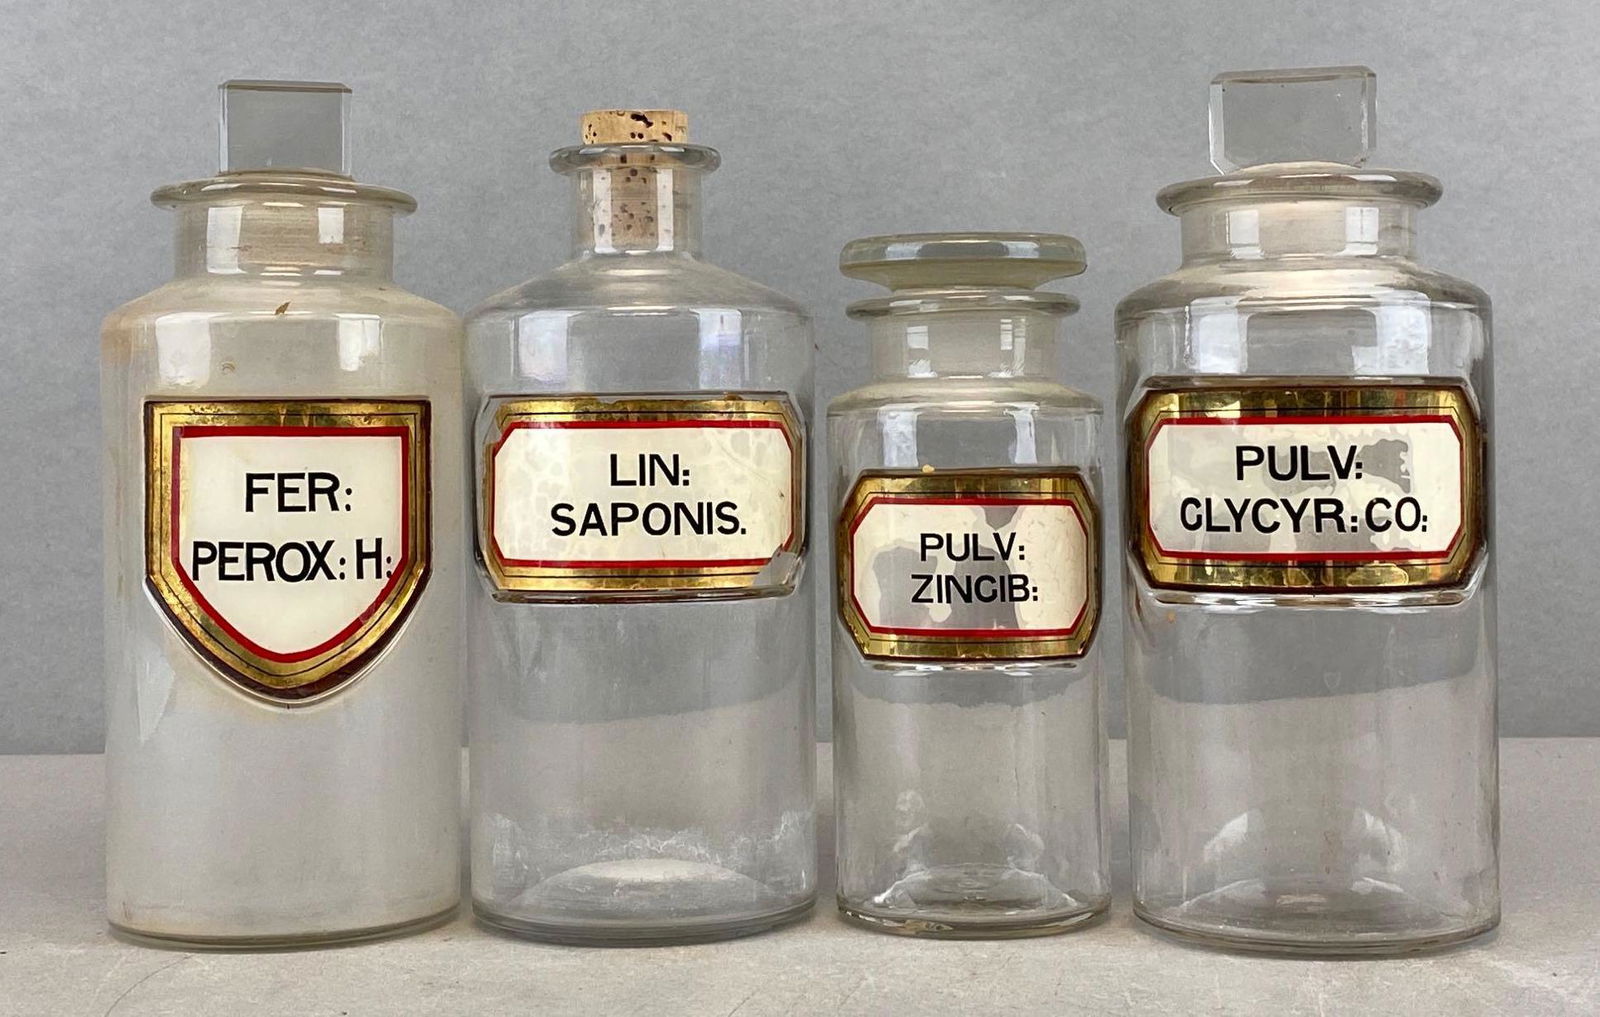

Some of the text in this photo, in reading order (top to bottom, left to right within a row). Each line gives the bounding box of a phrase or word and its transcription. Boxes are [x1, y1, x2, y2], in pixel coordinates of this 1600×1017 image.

[610, 453, 690, 487] LIN:
[1235, 445, 1363, 482] PULV:
[245, 472, 353, 513] FER:
[551, 501, 746, 537] SAPONIS.
[920, 532, 1025, 562] PULV:
